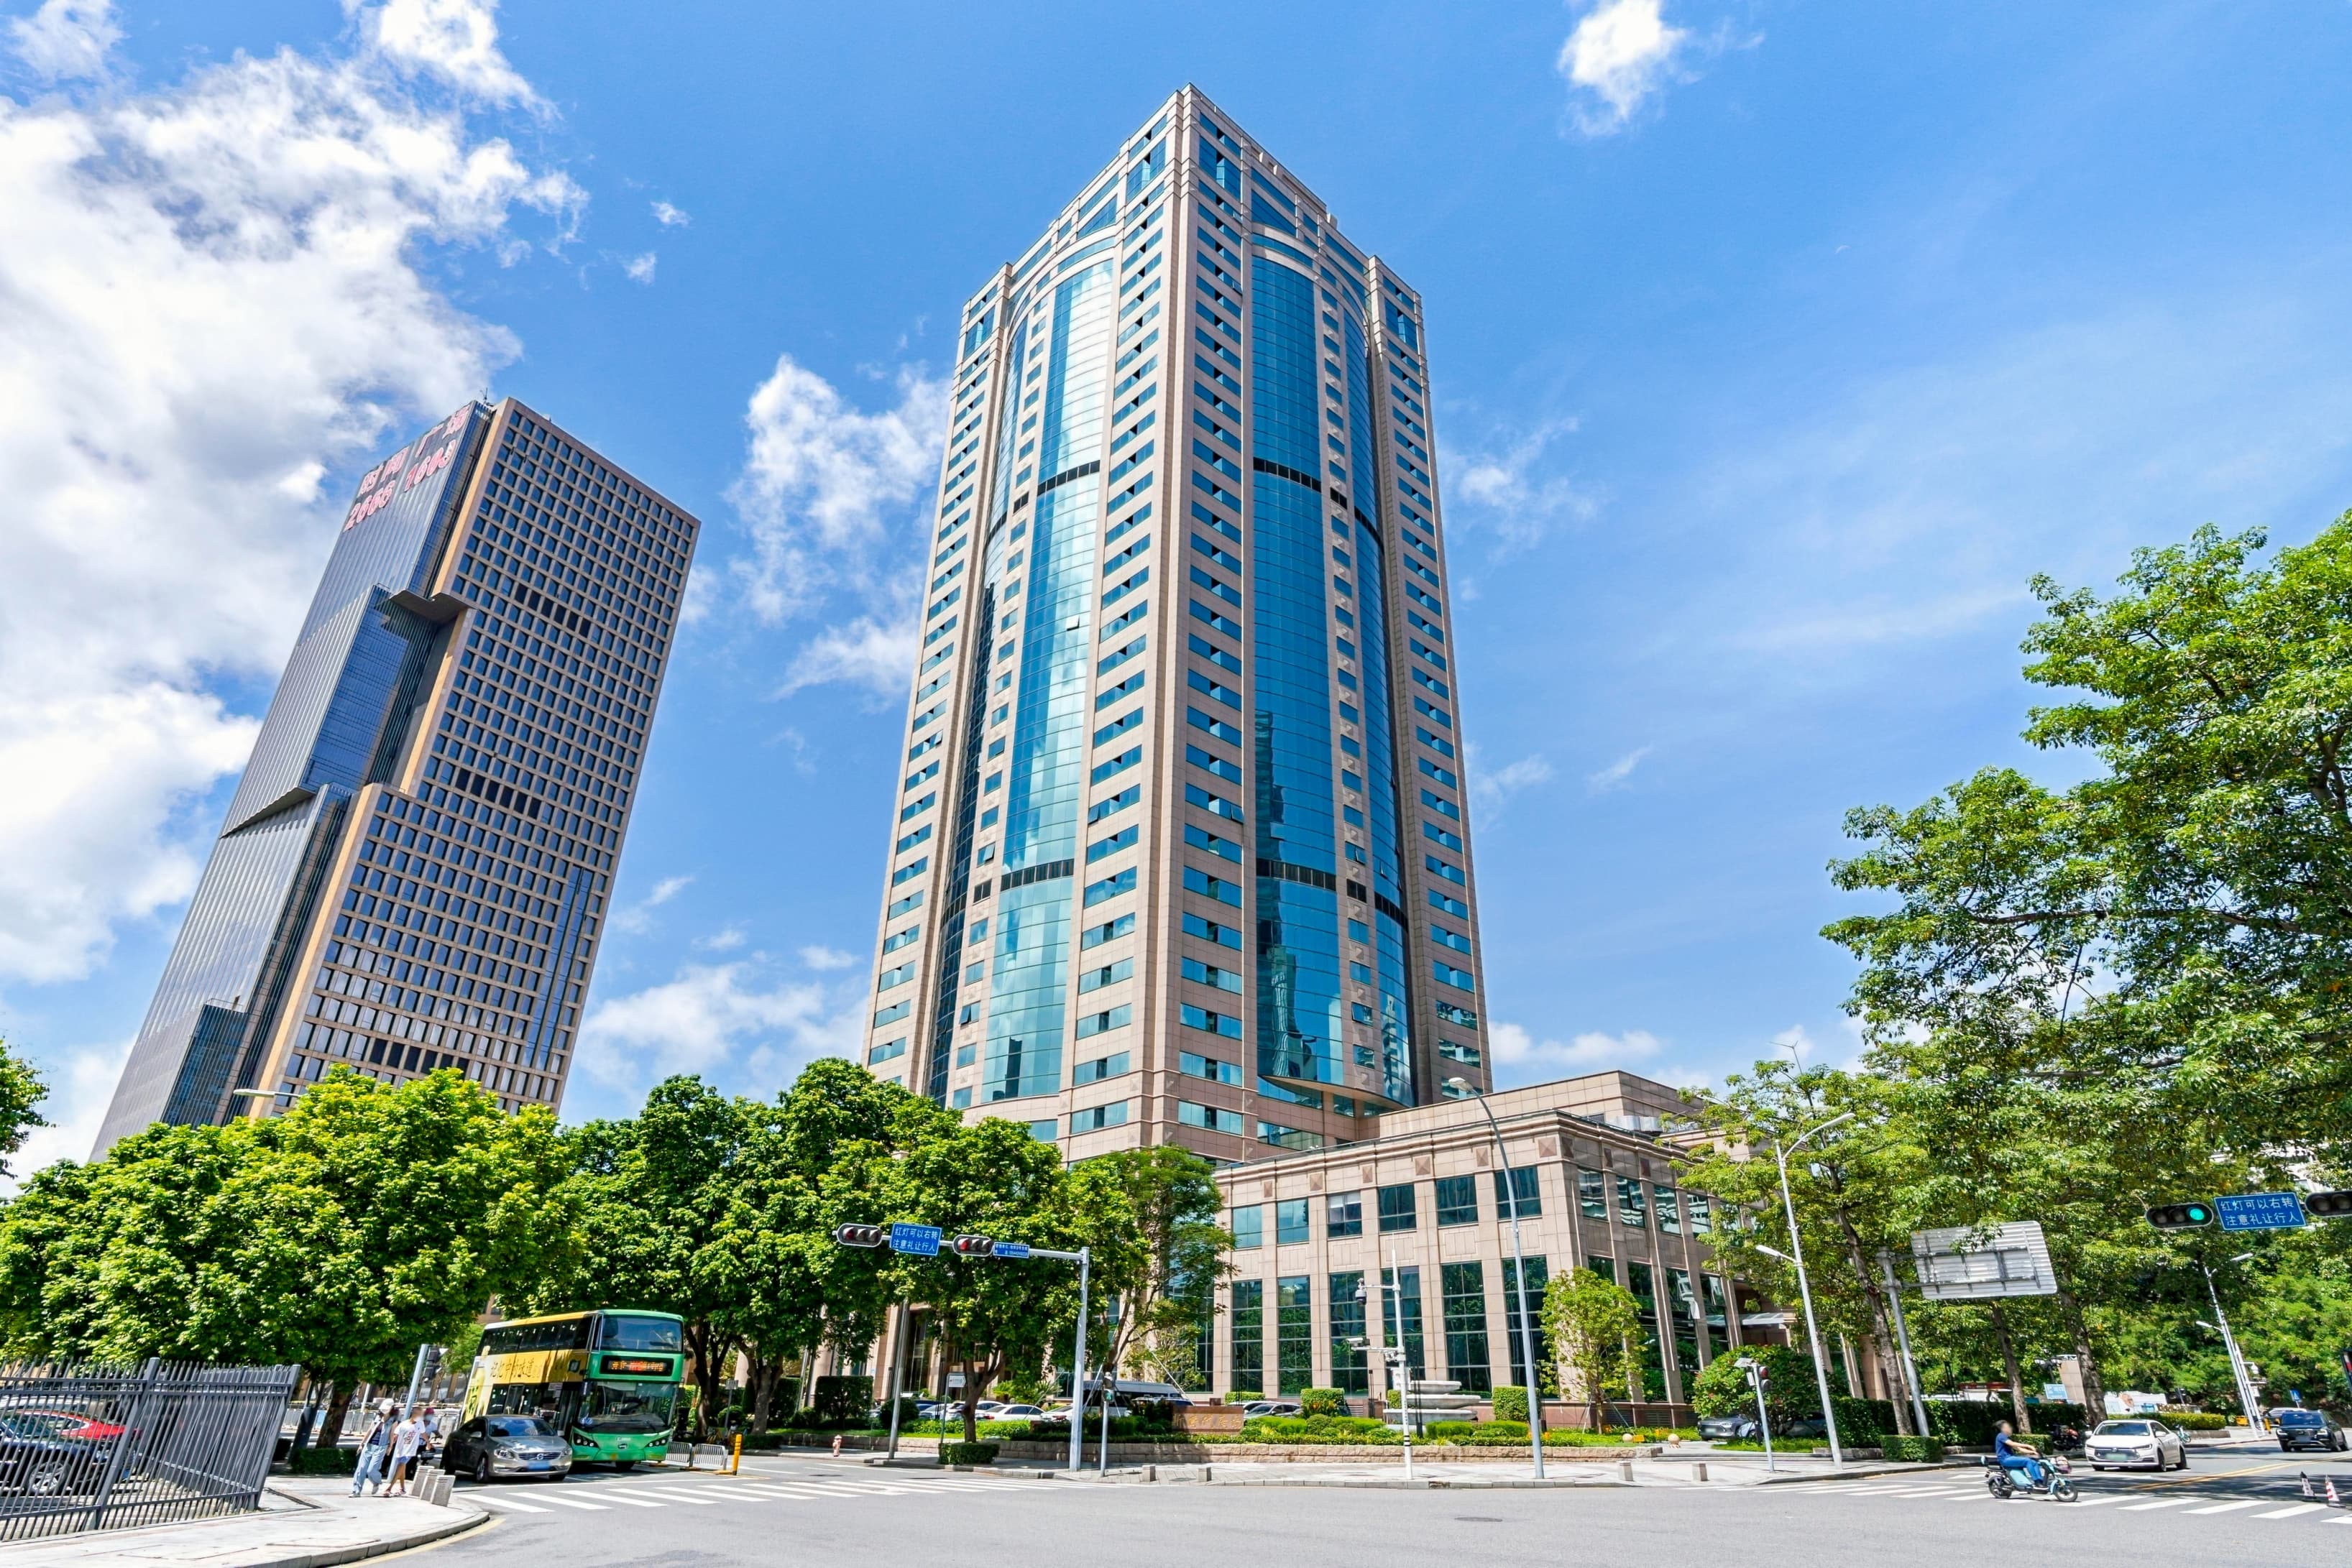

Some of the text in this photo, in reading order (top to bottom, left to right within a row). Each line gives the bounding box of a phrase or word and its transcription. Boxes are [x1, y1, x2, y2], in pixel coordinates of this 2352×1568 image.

[2220, 1196, 2294, 1211] 红灯可以右转
[2225, 1212, 2300, 1226] 注意礼让行人
[894, 1226, 938, 1240] 红灯可以右转
[892, 1239, 935, 1252] 注意礼让行人
